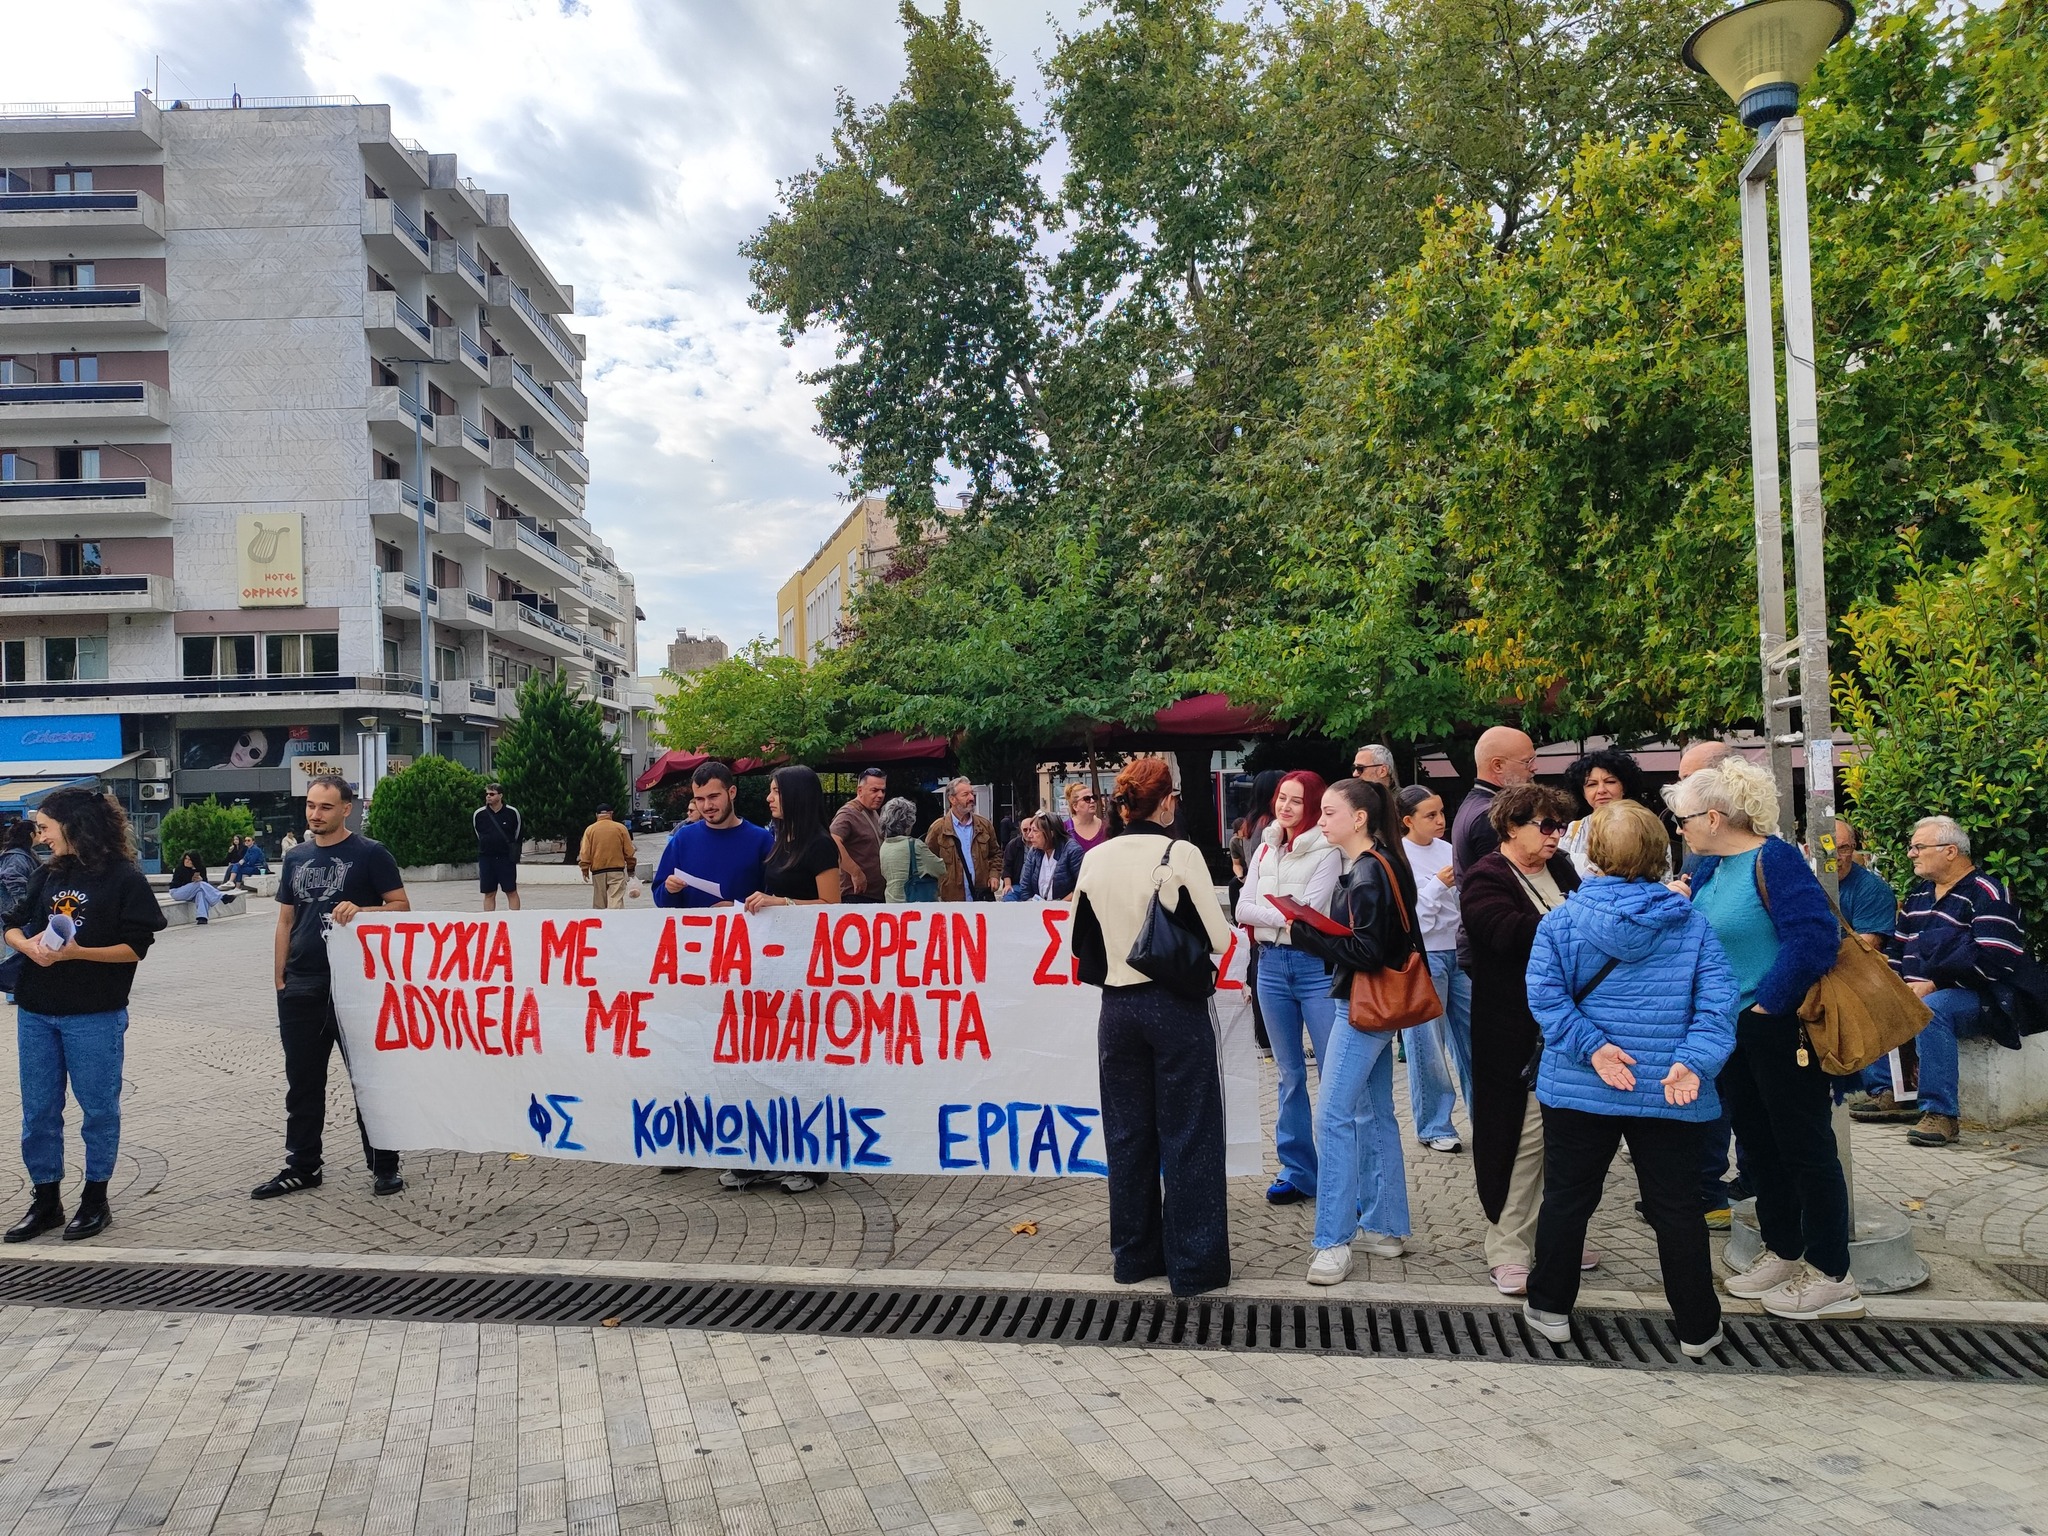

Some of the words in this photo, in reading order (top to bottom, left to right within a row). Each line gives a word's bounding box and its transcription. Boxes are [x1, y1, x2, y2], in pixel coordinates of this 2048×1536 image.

[264, 573, 296, 581] HOTEL
[318, 741, 330, 752] ON
[305, 766, 342, 776] STORES
[356, 920, 514, 983] ΠΤΥΧΙΑ
[540, 917, 603, 988] ΜΕ
[649, 913, 752, 986] ΑΞΙΑ
[806, 910, 987, 988] ΔΩΡΕΑΝ
[375, 982, 542, 1057] ΔΟΥΛΕΙΑ
[585, 989, 654, 1059] ΜΕ
[713, 989, 991, 1066] ΔΙΚΑΙΩΜΑΤΑ
[527, 1093, 587, 1152] ΦΣ
[631, 1093, 893, 1171] ΚΟΙΝΩΝΙΚΗΣ
[938, 1101, 1110, 1178] ΕΡΓΑΣ
